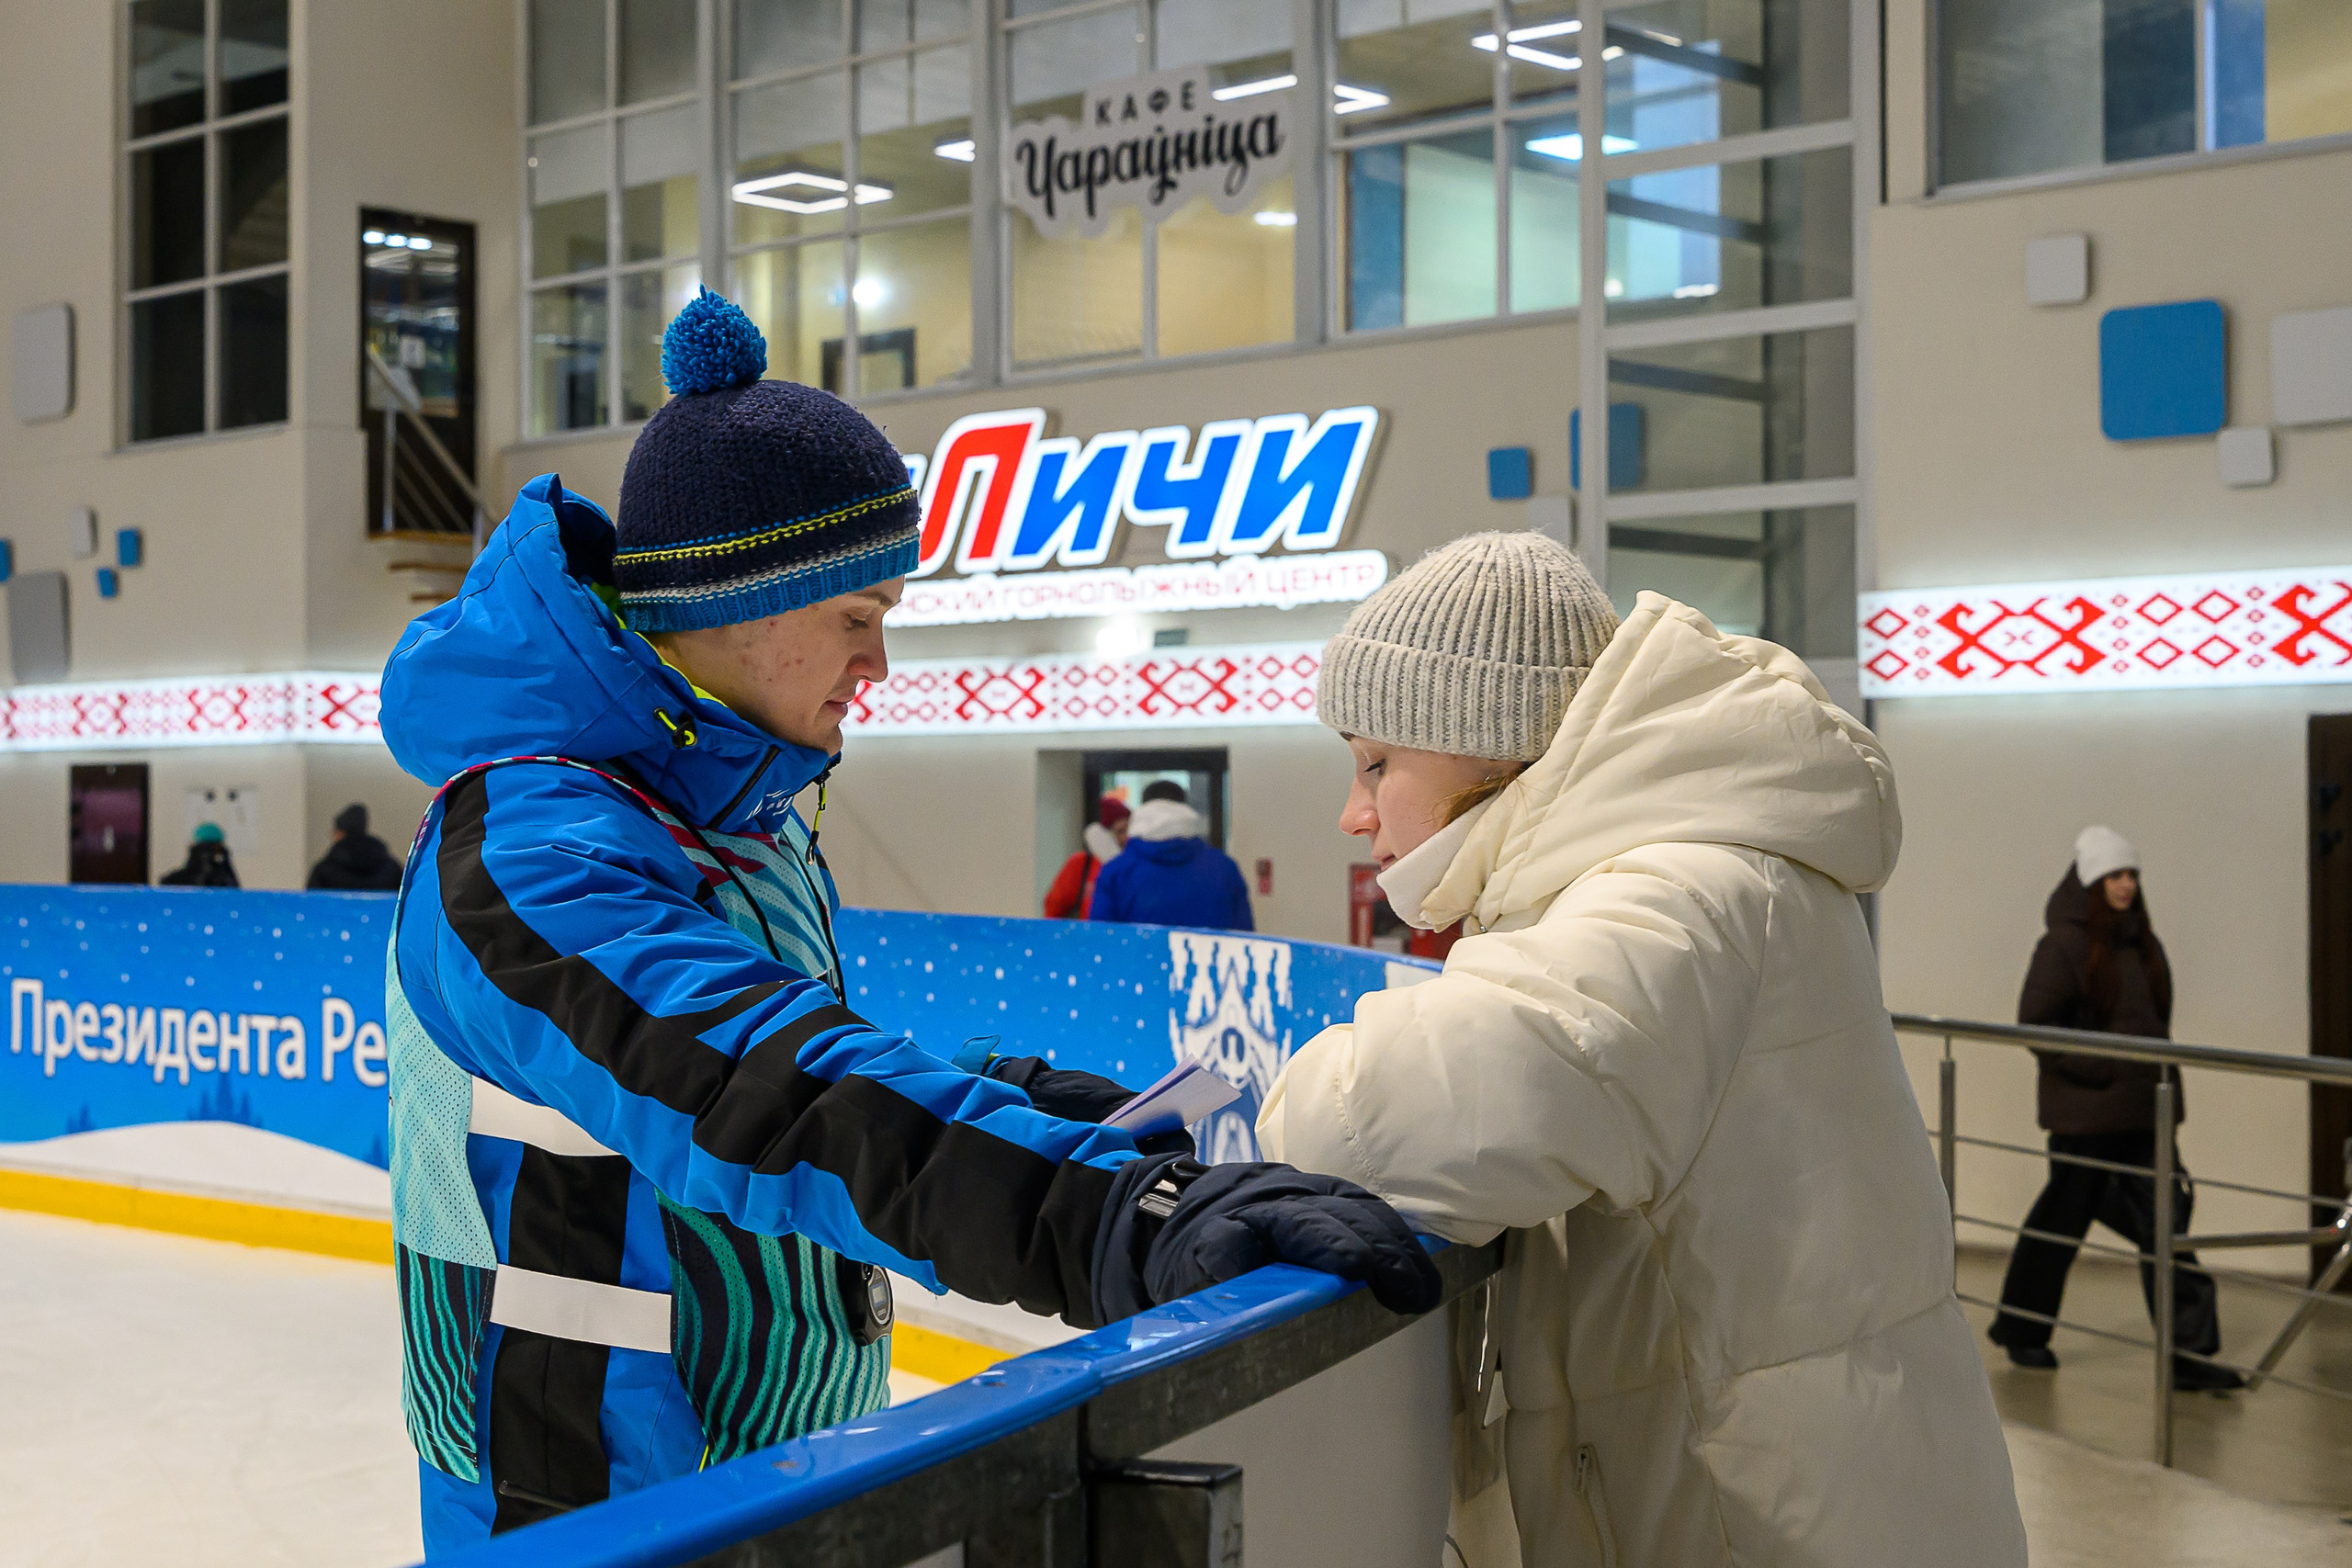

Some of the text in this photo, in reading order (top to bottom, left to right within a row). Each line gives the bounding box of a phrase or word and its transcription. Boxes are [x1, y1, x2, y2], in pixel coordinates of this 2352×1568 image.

[1094, 80, 1195, 124] КАФЕ
[1002, 562, 1256, 610] ГОРНОЛЫЖНЫЙ
[1266, 564, 1382, 602] ЦЕНТР
[10, 977, 387, 1088] Президента Ре
